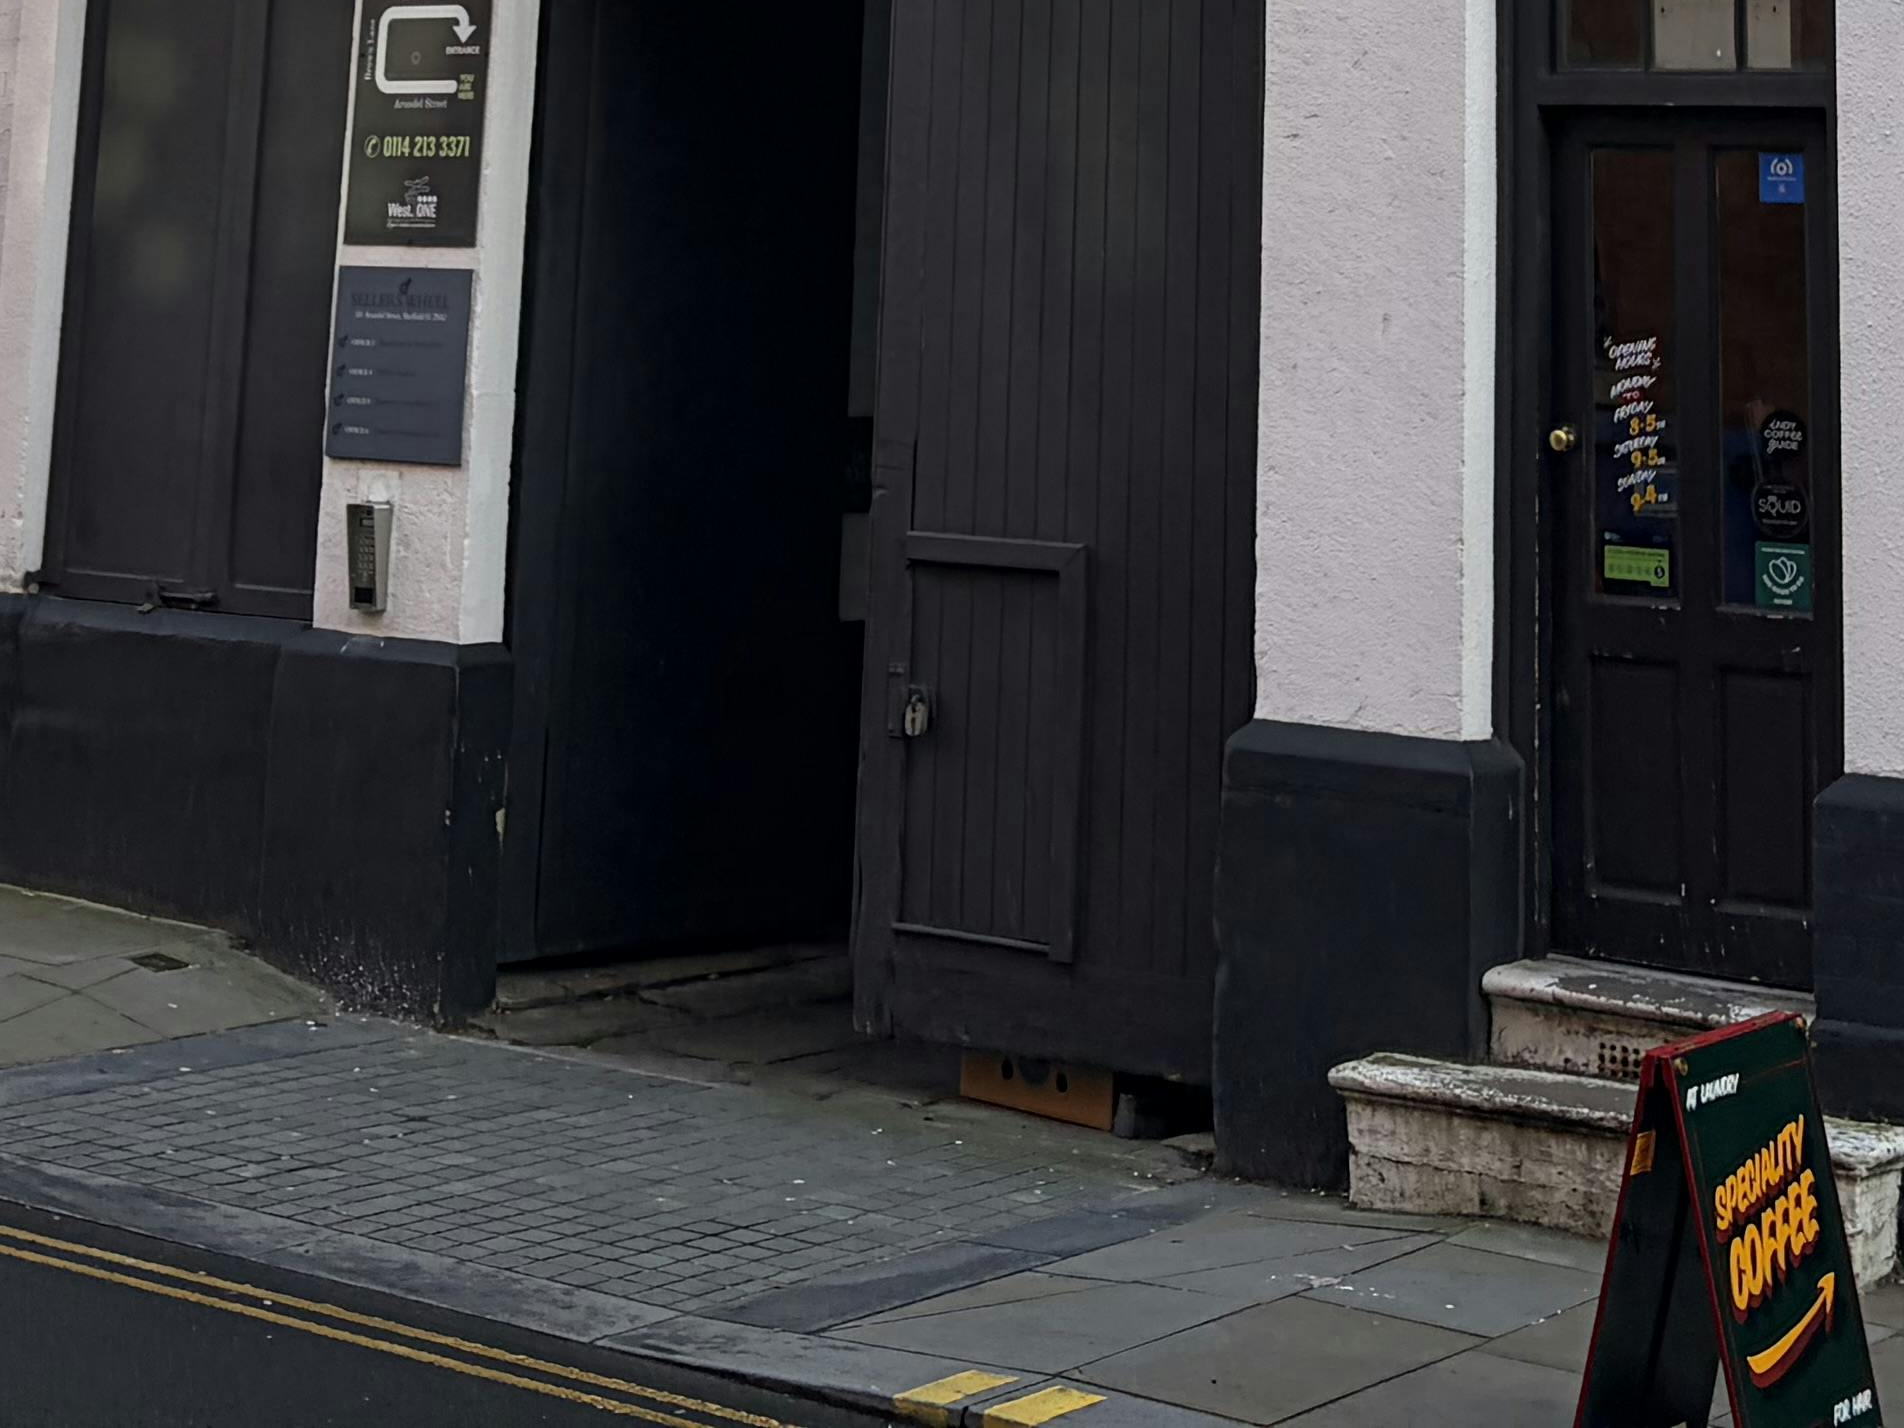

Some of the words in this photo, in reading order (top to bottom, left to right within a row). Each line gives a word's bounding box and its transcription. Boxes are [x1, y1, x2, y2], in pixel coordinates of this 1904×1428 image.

[382, 136, 410, 158] 0114
[413, 135, 436, 157] 213
[439, 135, 470, 157] 3371
[1714, 1114, 1805, 1236] SPECIALITY
[1729, 1167, 1820, 1316] COFFEE
